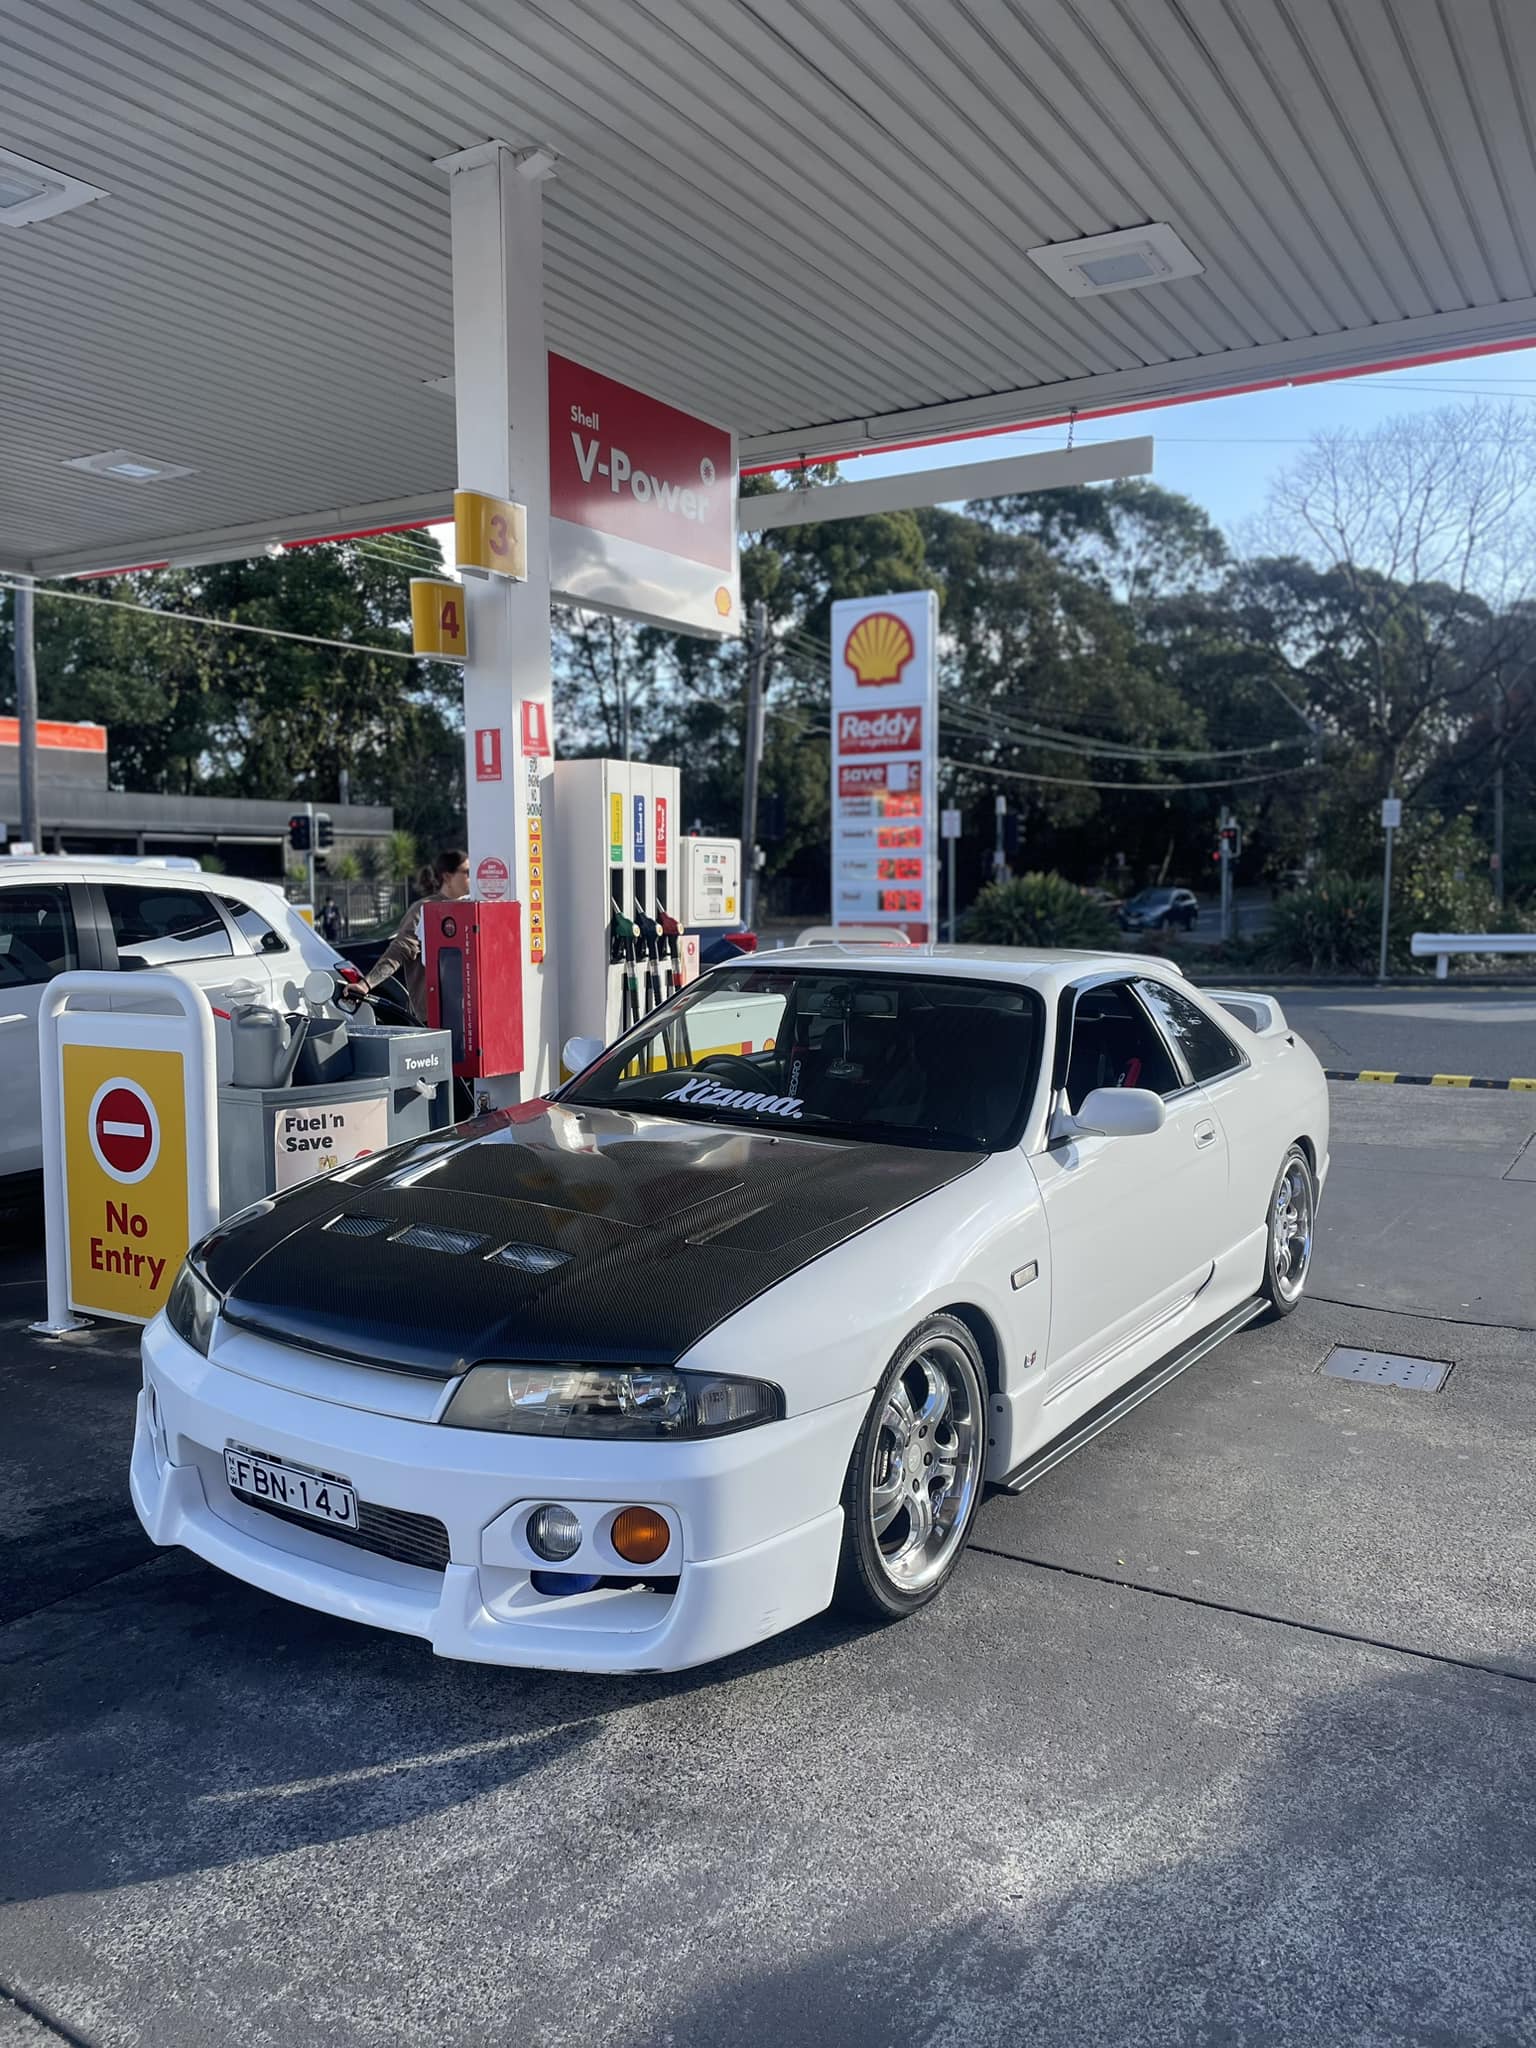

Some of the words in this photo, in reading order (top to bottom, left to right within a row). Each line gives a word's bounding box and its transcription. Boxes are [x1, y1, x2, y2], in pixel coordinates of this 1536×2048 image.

[570, 405, 600, 431] Shell
[570, 431, 712, 523] V-Power
[488, 514, 509, 556] 3
[441, 601, 460, 639] 4
[841, 712, 917, 745] Reddy
[841, 767, 885, 782] save
[404, 1053, 440, 1071] Towels
[284, 1114, 327, 1131] Fuel
[284, 1135, 333, 1153] Save
[105, 1200, 149, 1239] No
[90, 1237, 167, 1290] Entry
